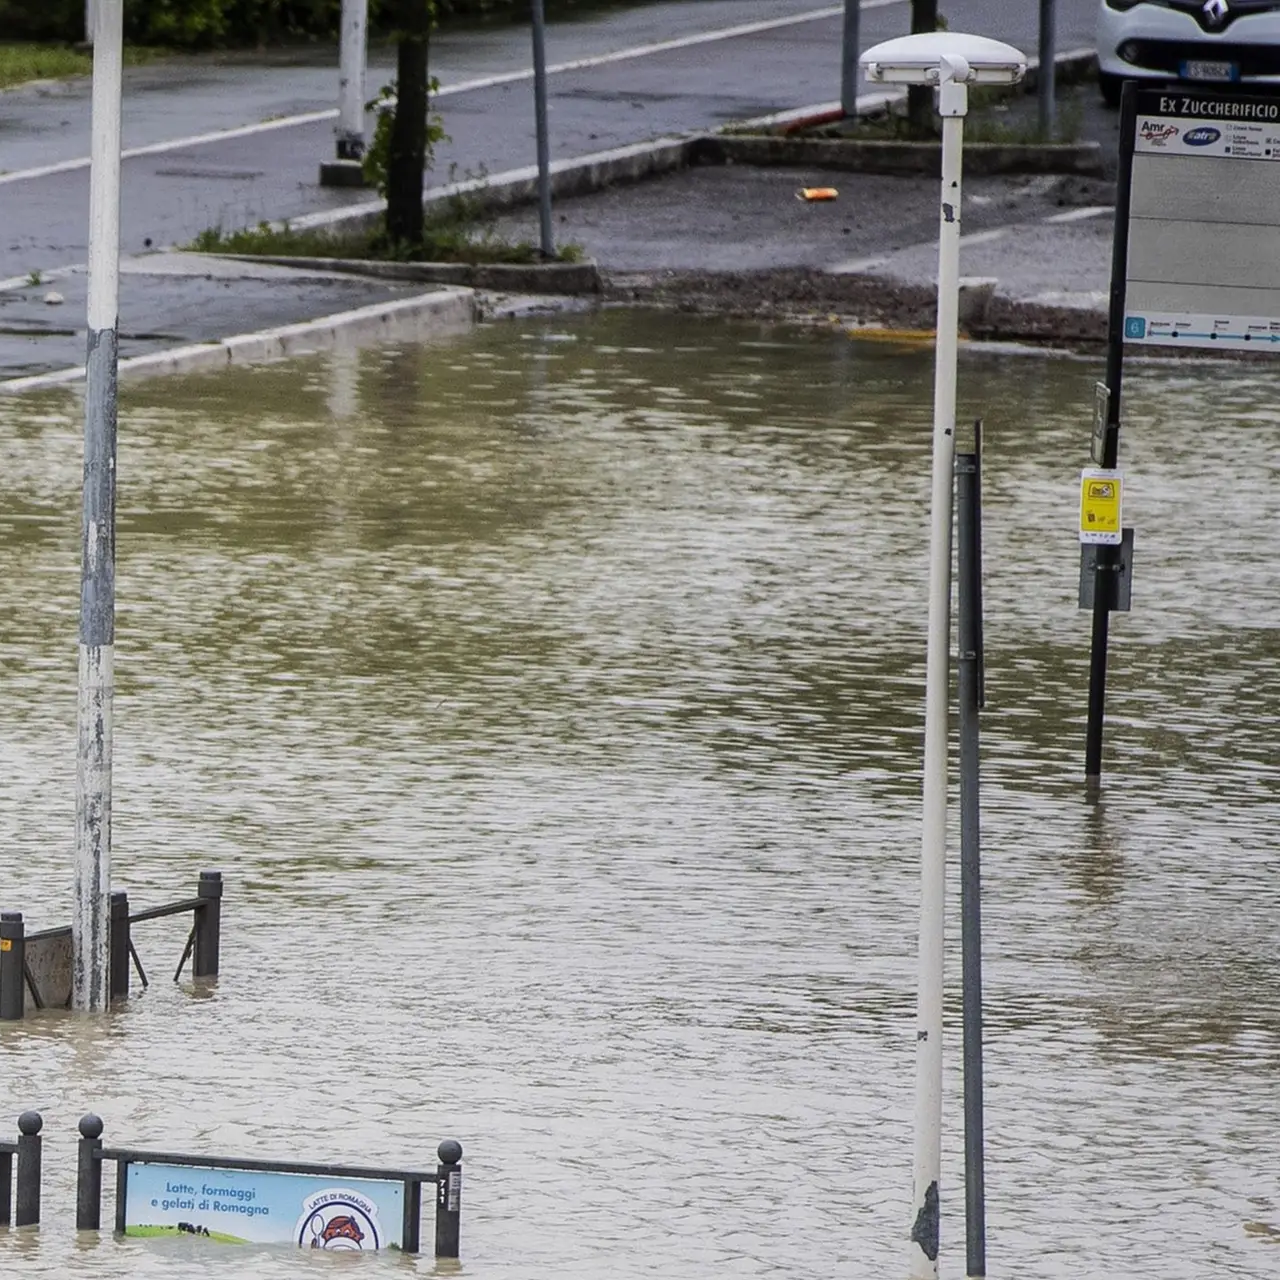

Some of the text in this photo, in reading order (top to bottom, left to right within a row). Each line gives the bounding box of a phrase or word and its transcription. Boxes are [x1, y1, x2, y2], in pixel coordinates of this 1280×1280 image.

[1142, 121, 1165, 132] Amr
[165, 1182, 256, 1202] Latte, formaggi
[151, 1198, 269, 1217] e gelati di Romagna
[308, 1193, 373, 1214] LATTE DI ROMAGNA
